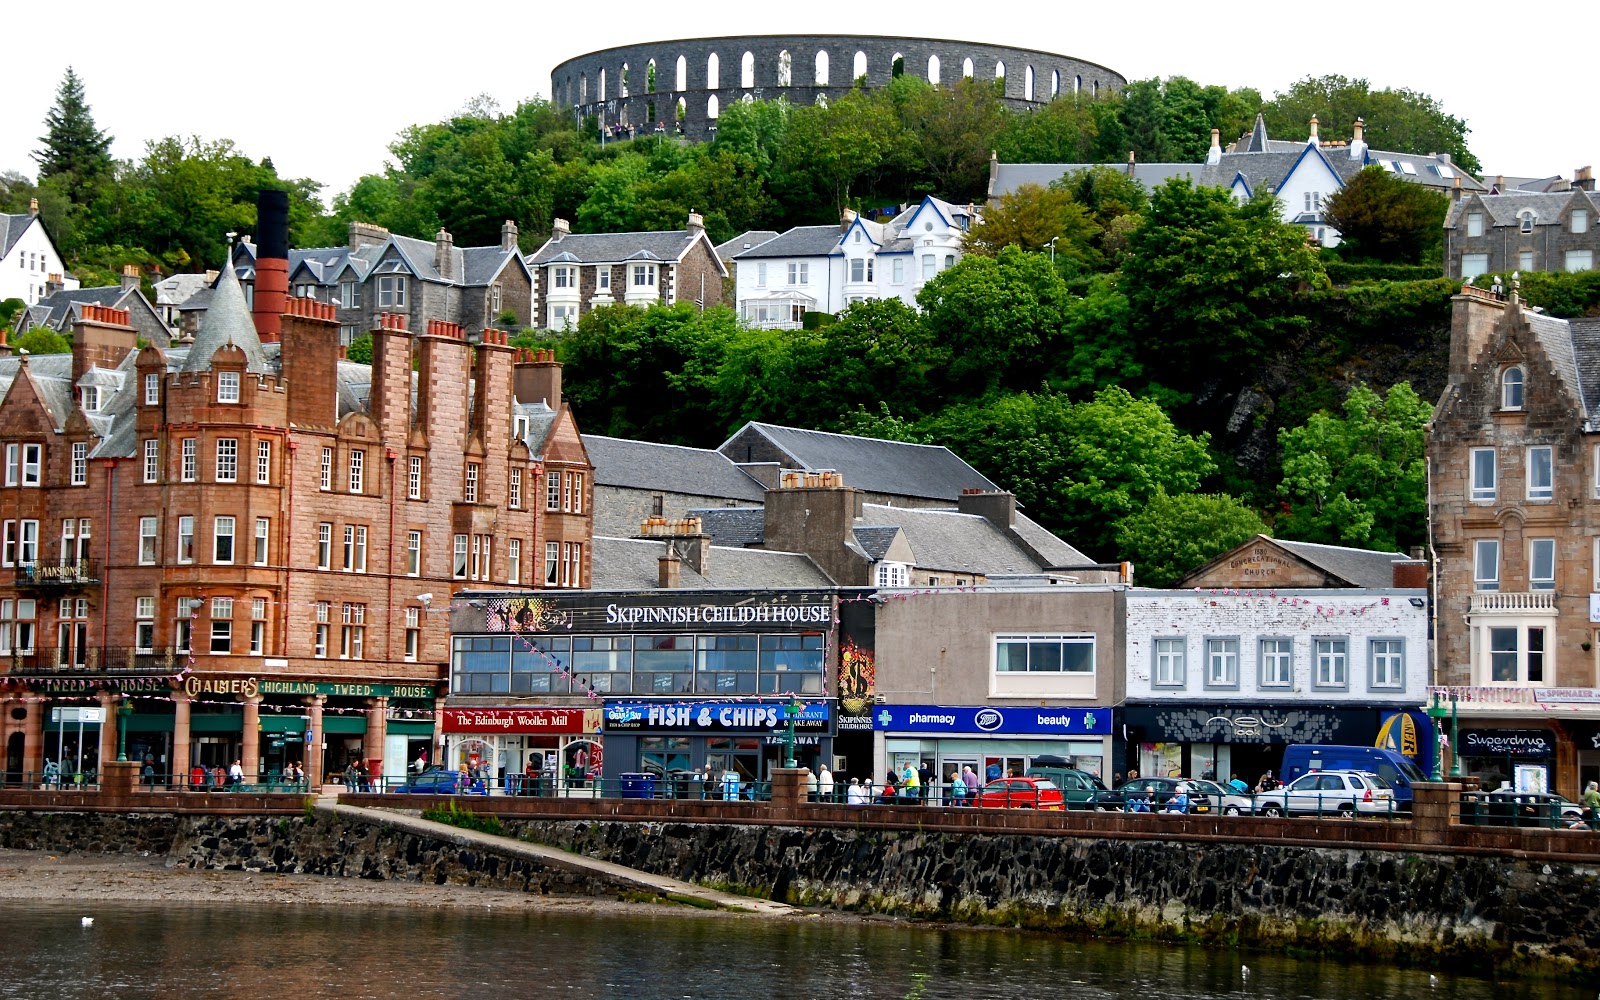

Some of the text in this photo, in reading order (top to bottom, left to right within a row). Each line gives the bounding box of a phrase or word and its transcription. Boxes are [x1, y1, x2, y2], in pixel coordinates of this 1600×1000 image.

[1230, 555, 1291, 569] CONGREGATIONAL
[41, 566, 79, 577] MANSIONS
[1244, 568, 1276, 576] CHURCH
[606, 603, 830, 626] SKIPINNISH CEILIDH HOUSE
[47, 681, 160, 692] TWEED HOUSE
[185, 676, 258, 698] CHALMERS
[264, 681, 427, 697] HIGHLAND TWEED HOUSE
[1547, 689, 1593, 698] SPINNAKER
[457, 715, 568, 728] The Edinburgh Woollen Mill
[648, 707, 778, 727] FISH & CHIPS
[838, 714, 873, 724] SKIPINNIS
[909, 712, 956, 726] pharmacy
[1037, 714, 1070, 727] beauty
[1234, 728, 1261, 736] look
[765, 736, 819, 744] TAAWAY
[1467, 733, 1546, 748] Superdrug
